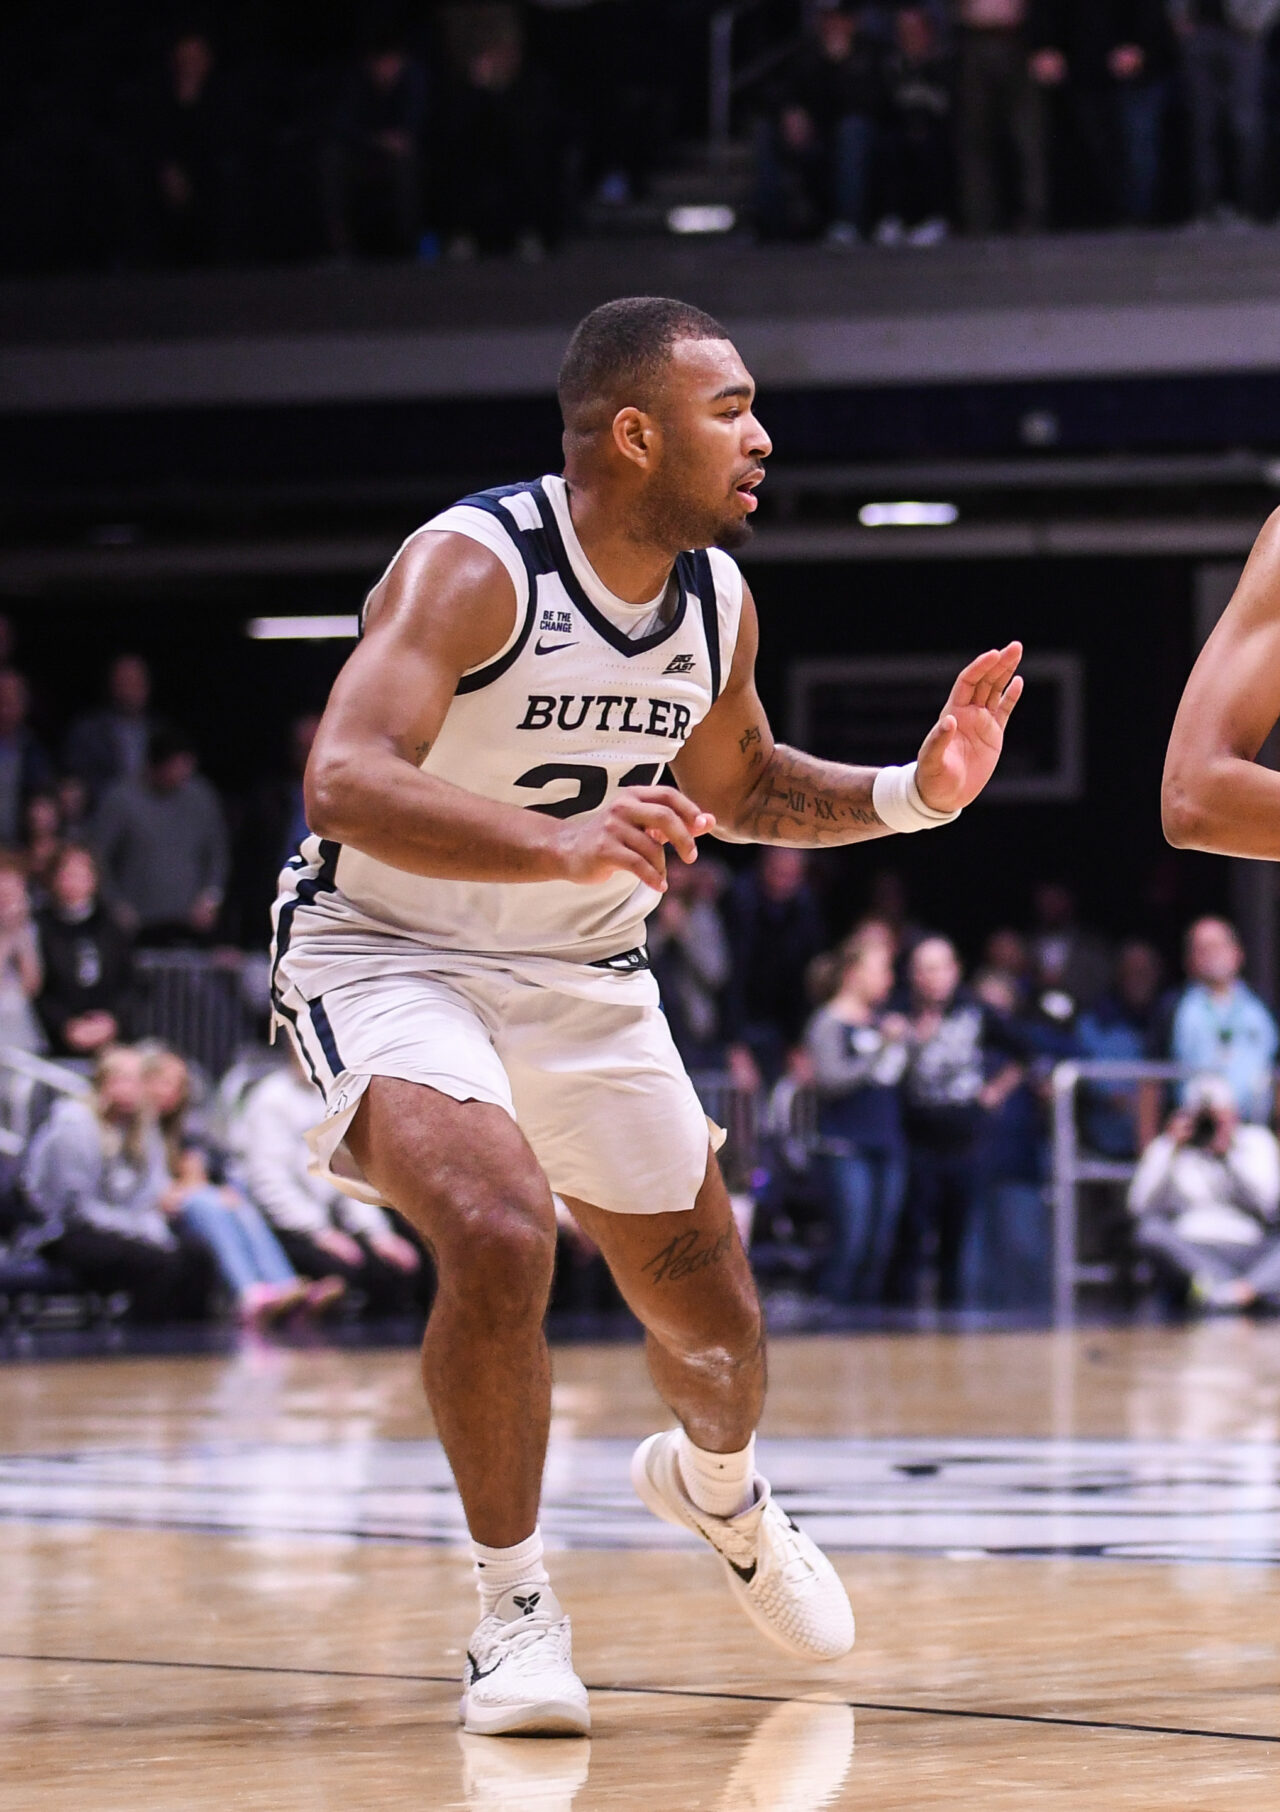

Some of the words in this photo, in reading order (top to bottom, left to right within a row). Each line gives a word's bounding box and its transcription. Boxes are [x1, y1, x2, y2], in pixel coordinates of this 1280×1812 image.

[543, 610, 554, 620] BE
[557, 612, 571, 622] THE
[540, 621, 572, 633] CHANGE
[672, 654, 693, 662] BIG
[665, 662, 696, 671] EAST
[516, 695, 691, 740] BUTLER
